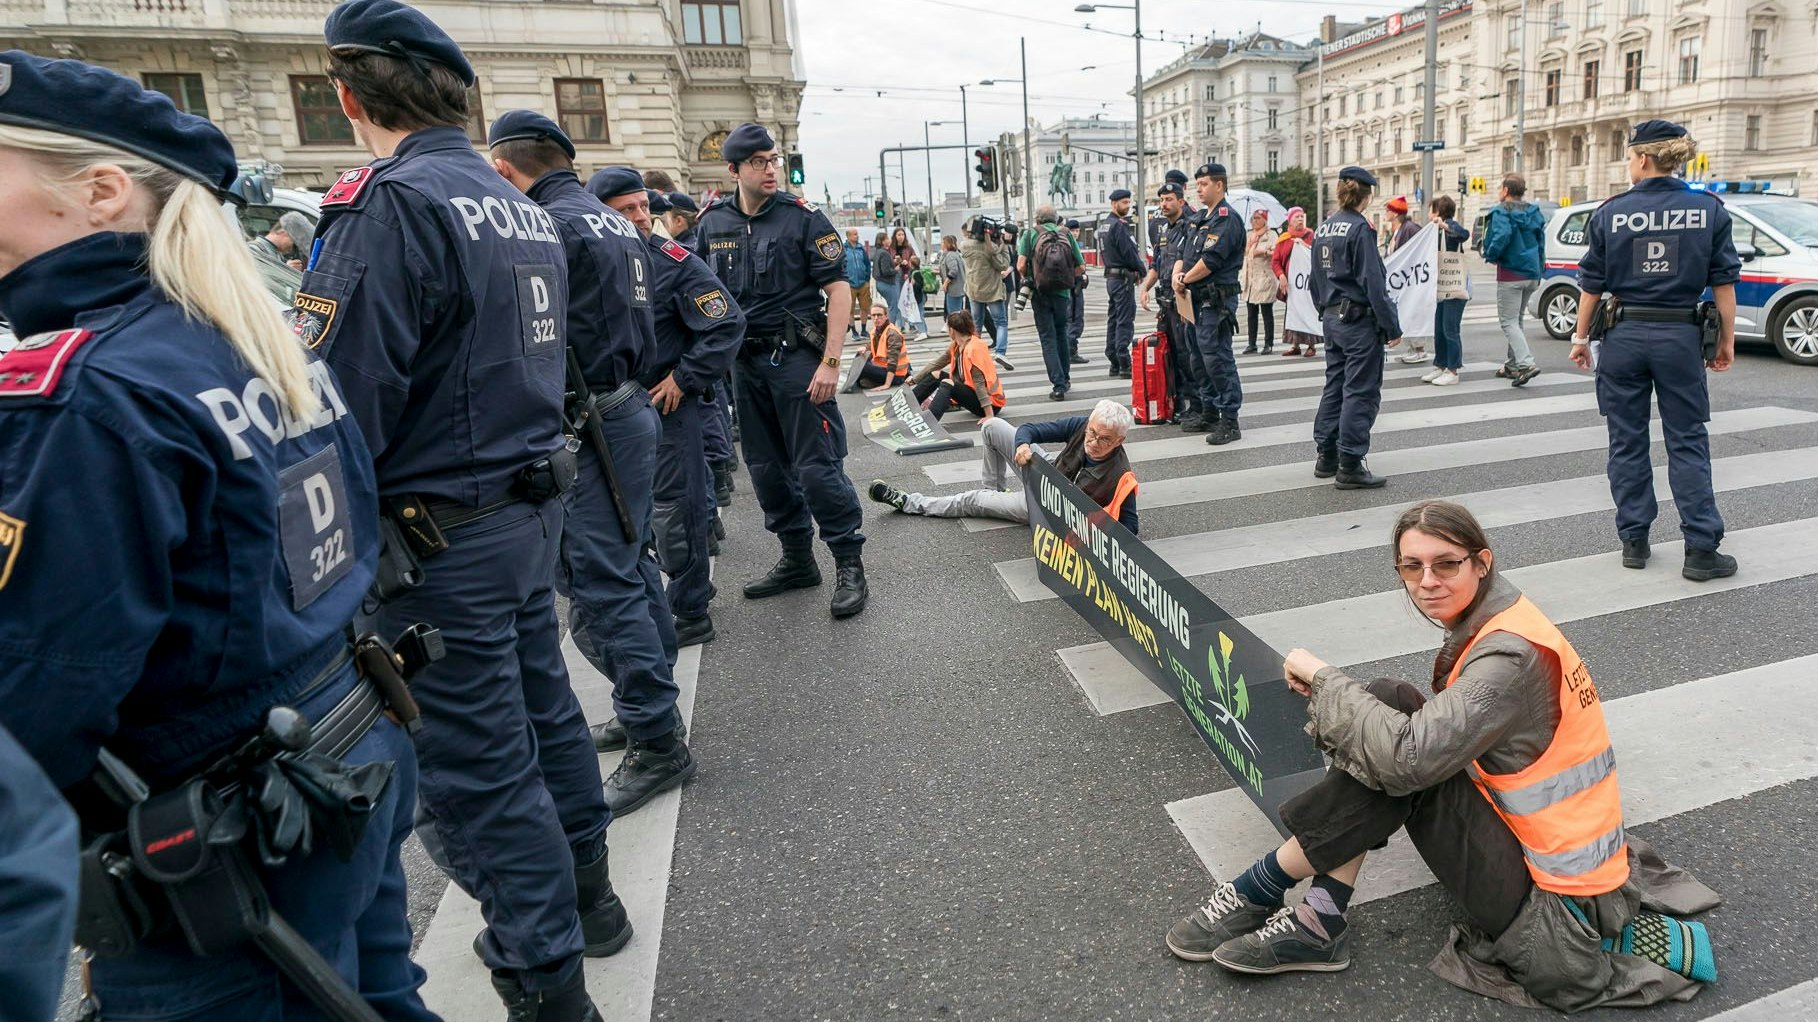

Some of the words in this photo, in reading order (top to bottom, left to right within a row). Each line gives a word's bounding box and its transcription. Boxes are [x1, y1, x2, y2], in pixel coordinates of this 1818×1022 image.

[449, 196, 560, 244] POLIZEI
[1611, 209, 1706, 233] POLIZEI
[1322, 246, 1329, 259] D
[1647, 242, 1665, 259] D
[634, 258, 643, 282] D
[1388, 262, 1429, 290] CHTS
[1642, 261, 1669, 273] 322
[295, 297, 332, 315] OLIZEI
[531, 277, 549, 313] D
[634, 286, 647, 301] 322
[532, 318, 556, 343] 322
[303, 473, 335, 534] D
[310, 528, 347, 583] 322
[1040, 474, 1061, 517] UND
[1062, 494, 1090, 549] WENN
[1091, 522, 1109, 569] DIE
[1111, 537, 1190, 650] REGIERUNG
[1033, 524, 1084, 590] KEINEN
[1085, 558, 1124, 627] PLAN
[1120, 600, 1163, 668] HAT?
[1166, 648, 1204, 706] LETZTE
